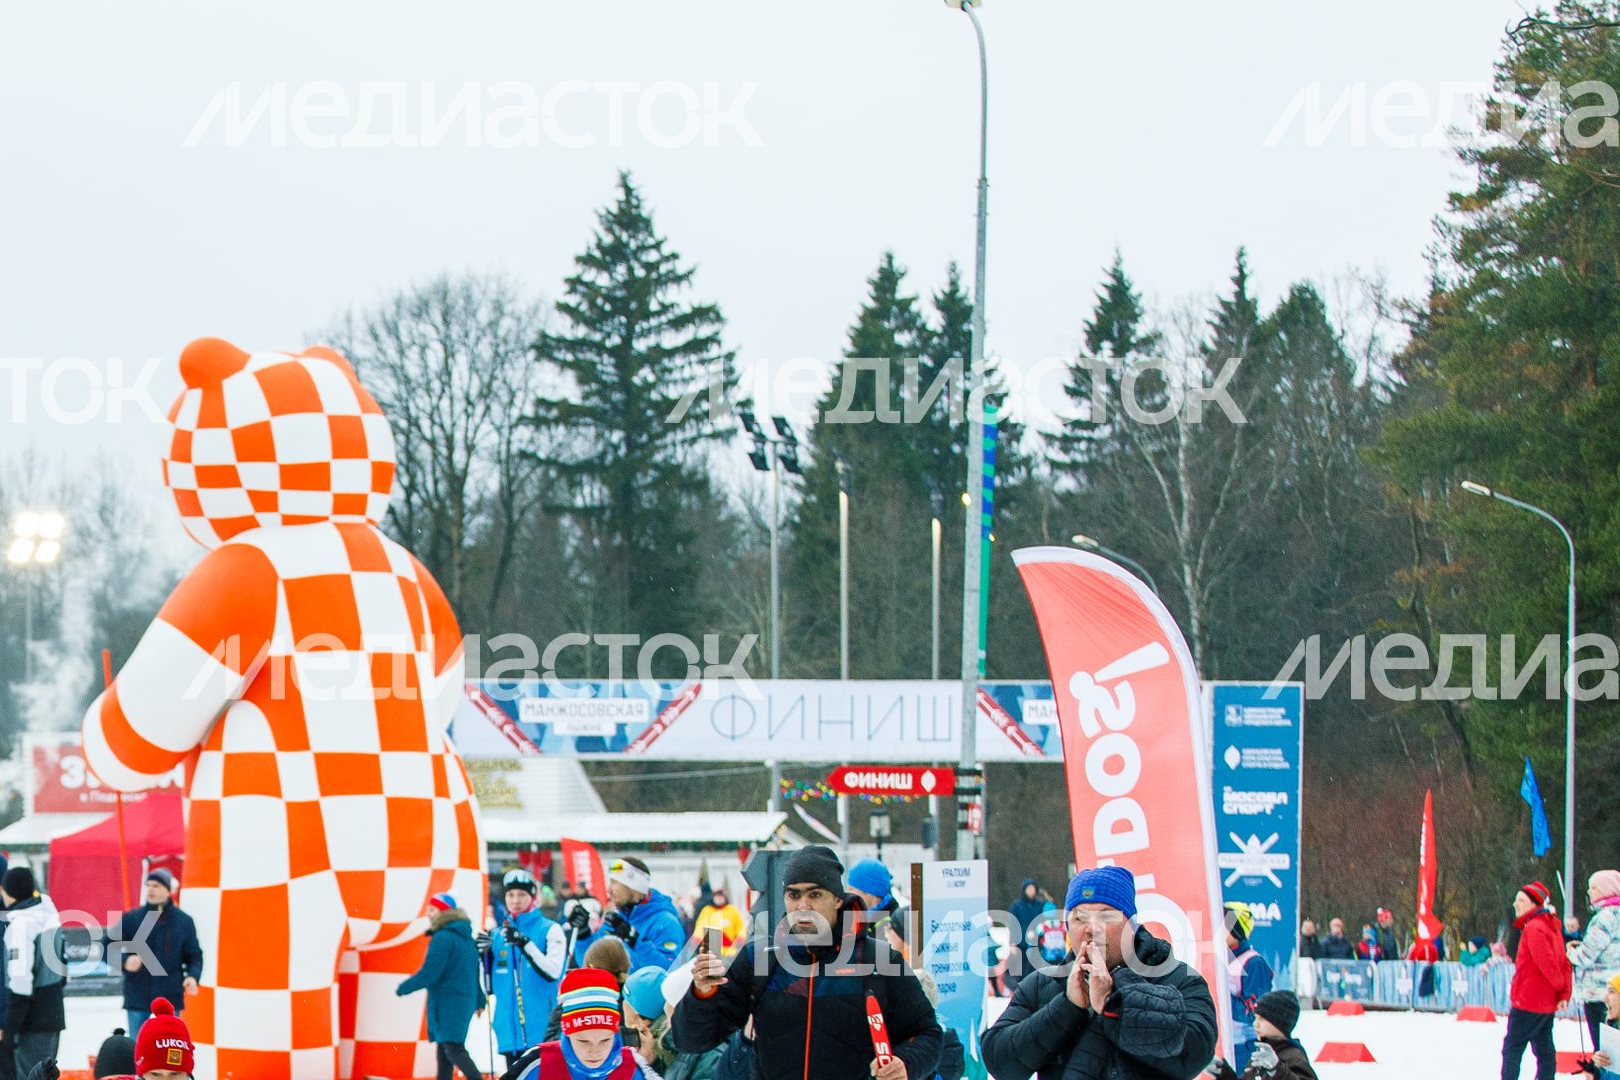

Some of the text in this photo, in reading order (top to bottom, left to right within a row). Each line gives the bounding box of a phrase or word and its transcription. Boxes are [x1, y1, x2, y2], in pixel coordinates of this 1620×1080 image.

[523, 703, 644, 718] МАНЖОСОВСКАЯ
[710, 690, 953, 743] ФИНИШ
[843, 770, 912, 791] ФИНИШ
